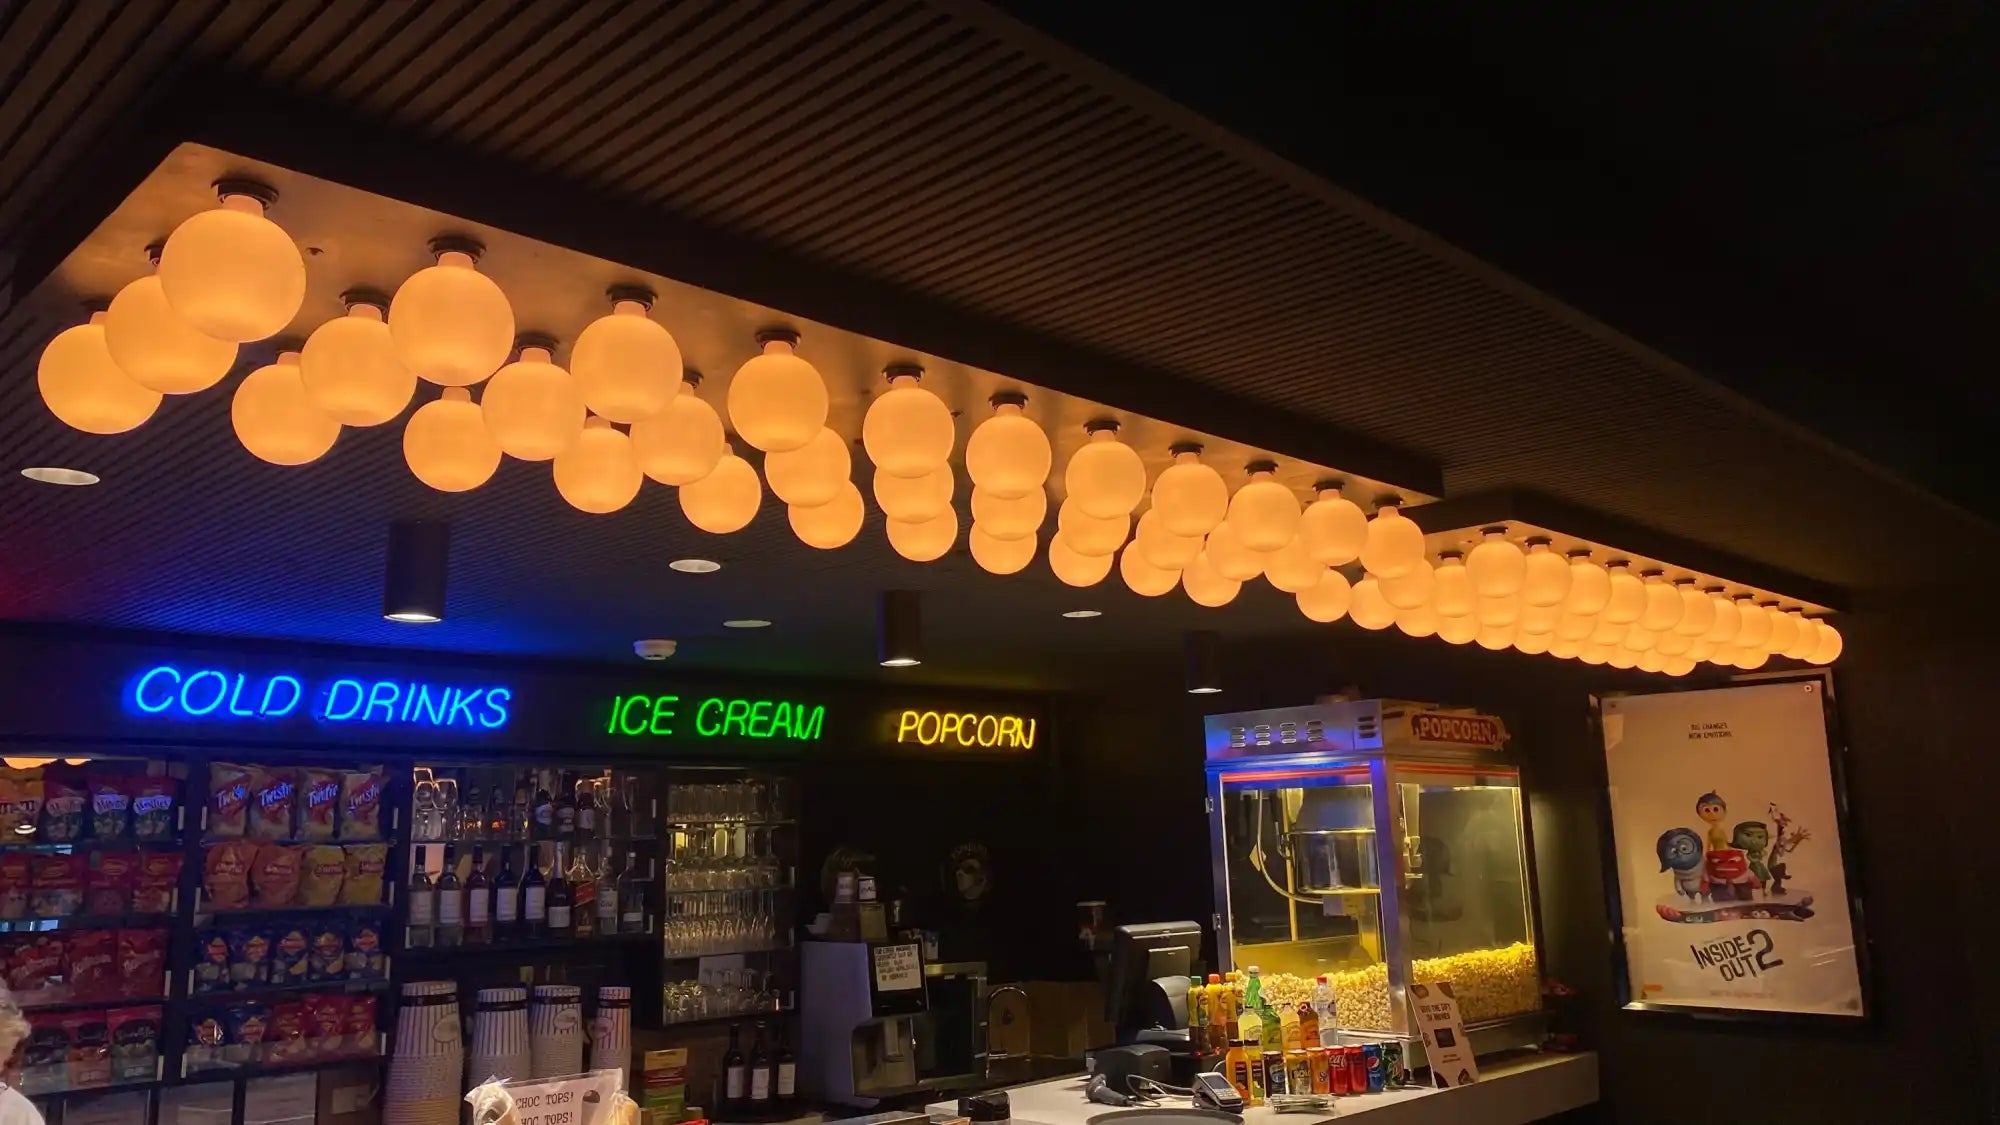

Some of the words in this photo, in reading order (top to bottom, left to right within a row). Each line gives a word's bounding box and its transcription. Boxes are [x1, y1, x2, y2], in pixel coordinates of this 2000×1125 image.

[135, 666, 301, 716] COLD
[324, 679, 511, 728] DRINKS
[608, 695, 679, 735] ICE
[696, 698, 825, 740] CREAM
[898, 710, 1036, 749] POPCORN
[1420, 717, 1492, 742] POPCORN
[1690, 935, 1752, 970] INSIDE
[1719, 954, 1757, 982] OUT
[1746, 929, 1784, 971] 2
[515, 1095, 540, 1109] CHOC
[545, 1091, 574, 1105] TOPS!
[520, 1116, 539, 1125] HOC
[544, 1111, 573, 1125] TOPS!
